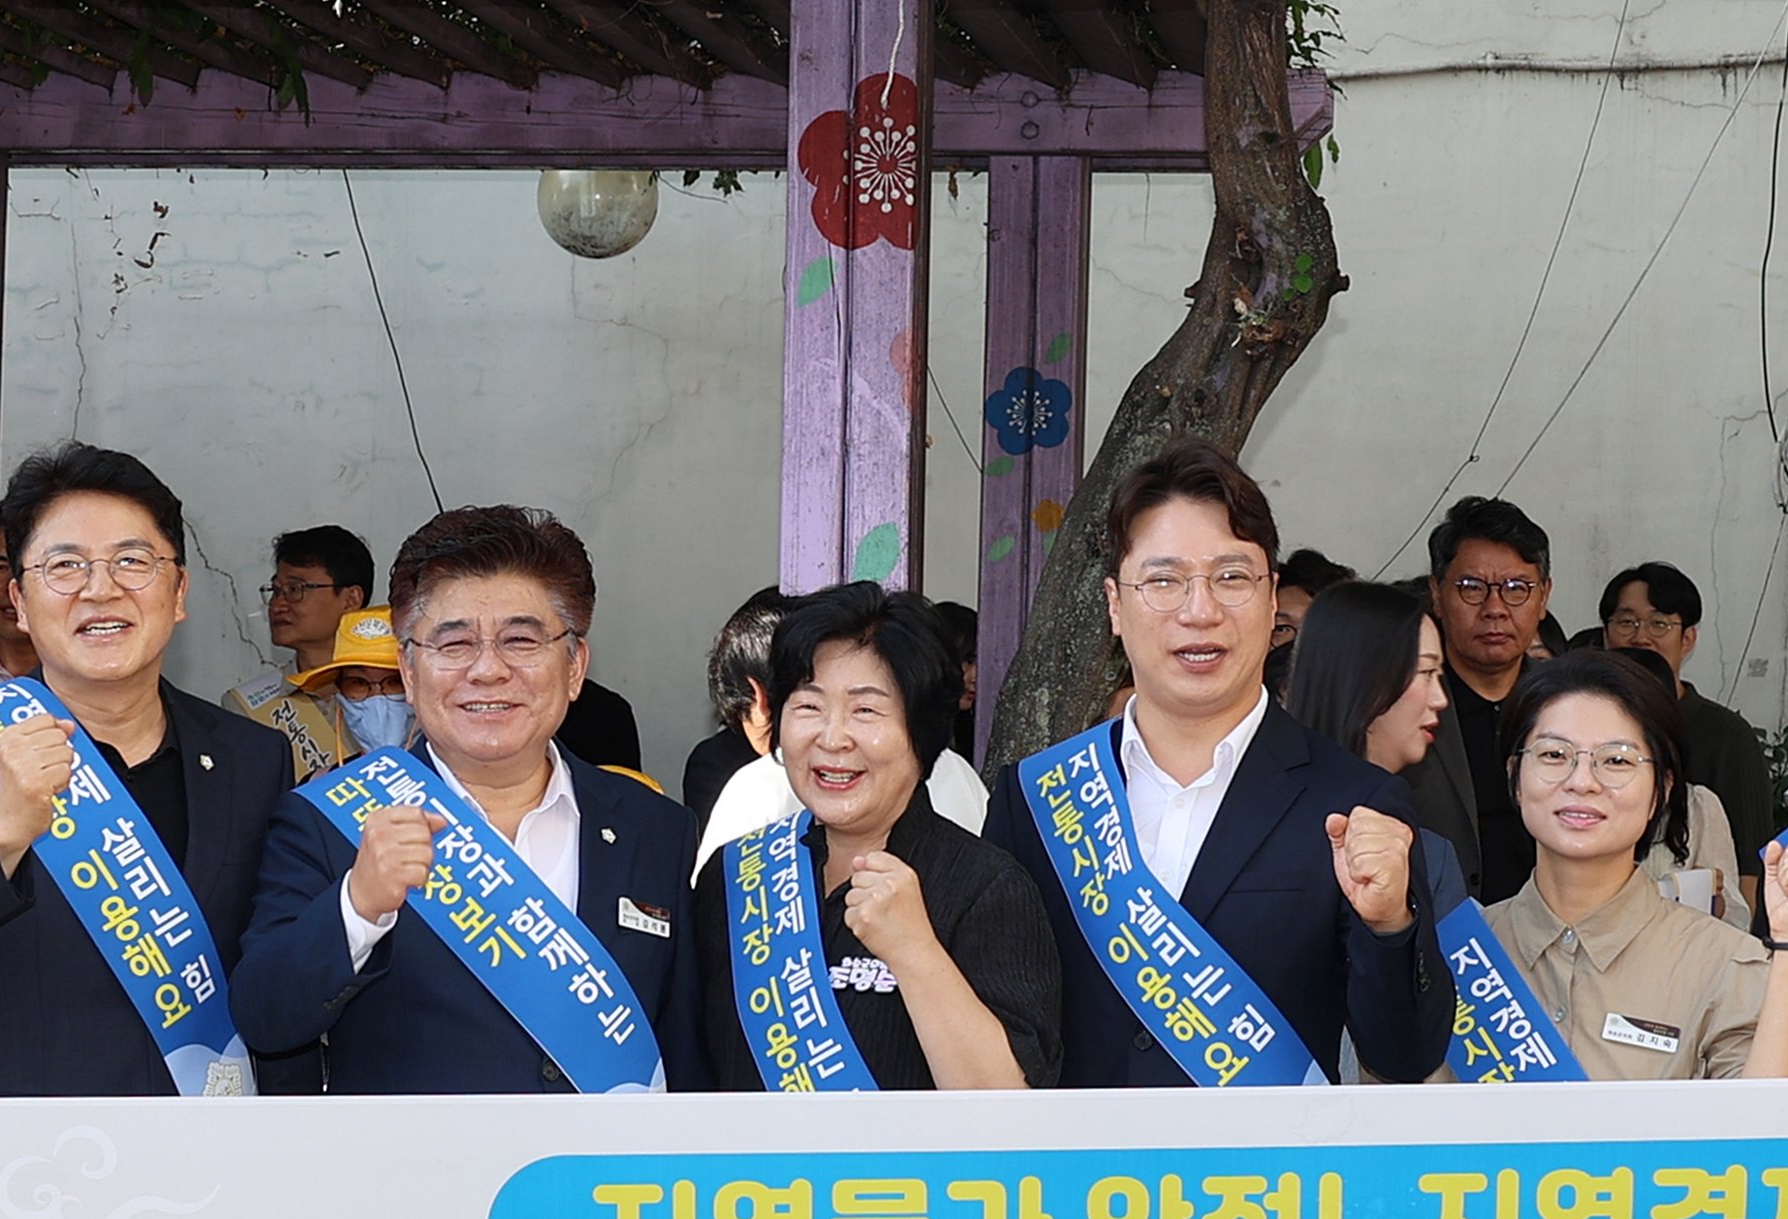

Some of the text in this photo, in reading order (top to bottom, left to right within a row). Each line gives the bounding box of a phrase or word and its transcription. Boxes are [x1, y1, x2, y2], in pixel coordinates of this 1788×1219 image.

[70, 848, 192, 1030] 이용해요
[102, 817, 193, 947] 살리는
[180, 954, 216, 1004] 힘
[422, 864, 527, 967] 장보기
[507, 897, 636, 1046] 함께하는
[736, 828, 773, 966] 전통시장
[769, 816, 845, 1079] 지역경제 살리는
[1036, 764, 1250, 1087] 전통시장 이용해요
[1069, 743, 1276, 1053] 지역경제 살리는 힘
[1450, 937, 1557, 1072] 지역경제
